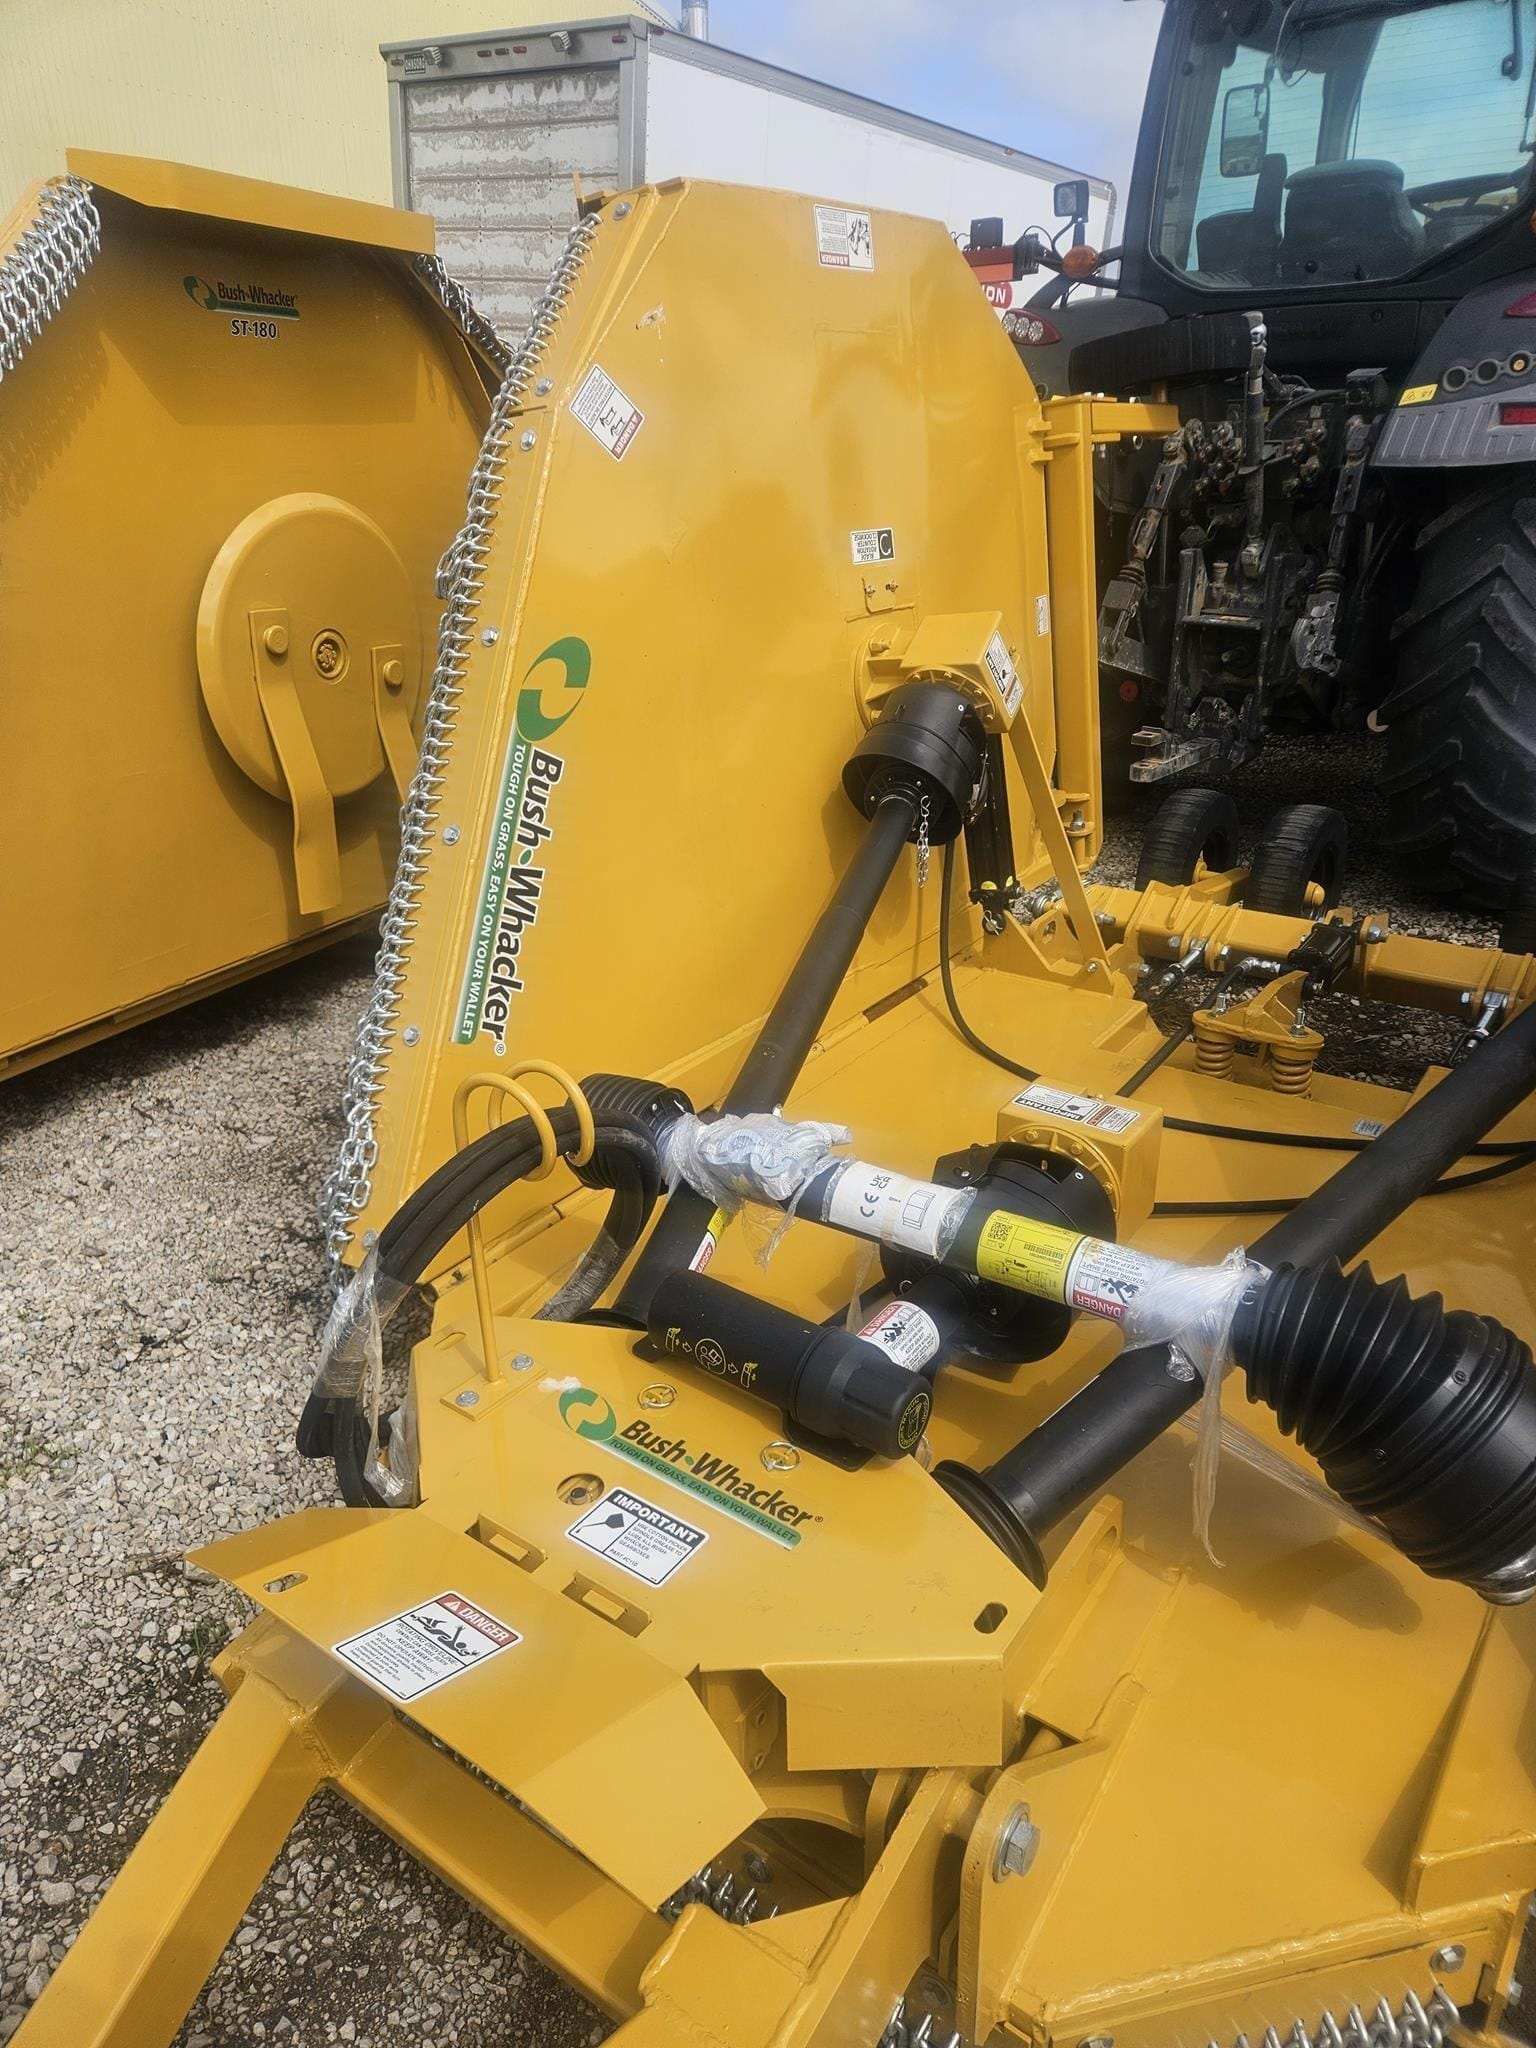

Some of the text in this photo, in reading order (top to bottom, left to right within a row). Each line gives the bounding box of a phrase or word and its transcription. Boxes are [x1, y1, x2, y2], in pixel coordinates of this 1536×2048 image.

[982, 284, 1006, 304] ON
[461, 743, 526, 1039] TOUGH ON GRASS, EASY ON YOUR WALLET
[1076, 1294, 1121, 1318] DANGER
[610, 1438, 798, 1542] TOUGH ON GRASS, EASY ON YOUR WALLET
[611, 1493, 700, 1544] IMPORTANT
[622, 1535, 650, 1551] WHACKER
[627, 1530, 642, 1540] LUBE
[631, 1526, 655, 1540] SPINDLE
[652, 1537, 676, 1552] GREASE
[646, 1528, 669, 1541] COTTON
[667, 1539, 688, 1552] PICKER
[608, 1548, 624, 1558] PART
[396, 1622, 427, 1643] ROTATING
[457, 1606, 510, 1642] DANGER
[384, 1637, 396, 1645] NOT
[393, 1644, 417, 1660] OPERATE
[394, 1628, 414, 1642] CONTACT
[420, 1646, 435, 1656] CAUSE
[395, 1636, 434, 1663] KEEP AWAY!
